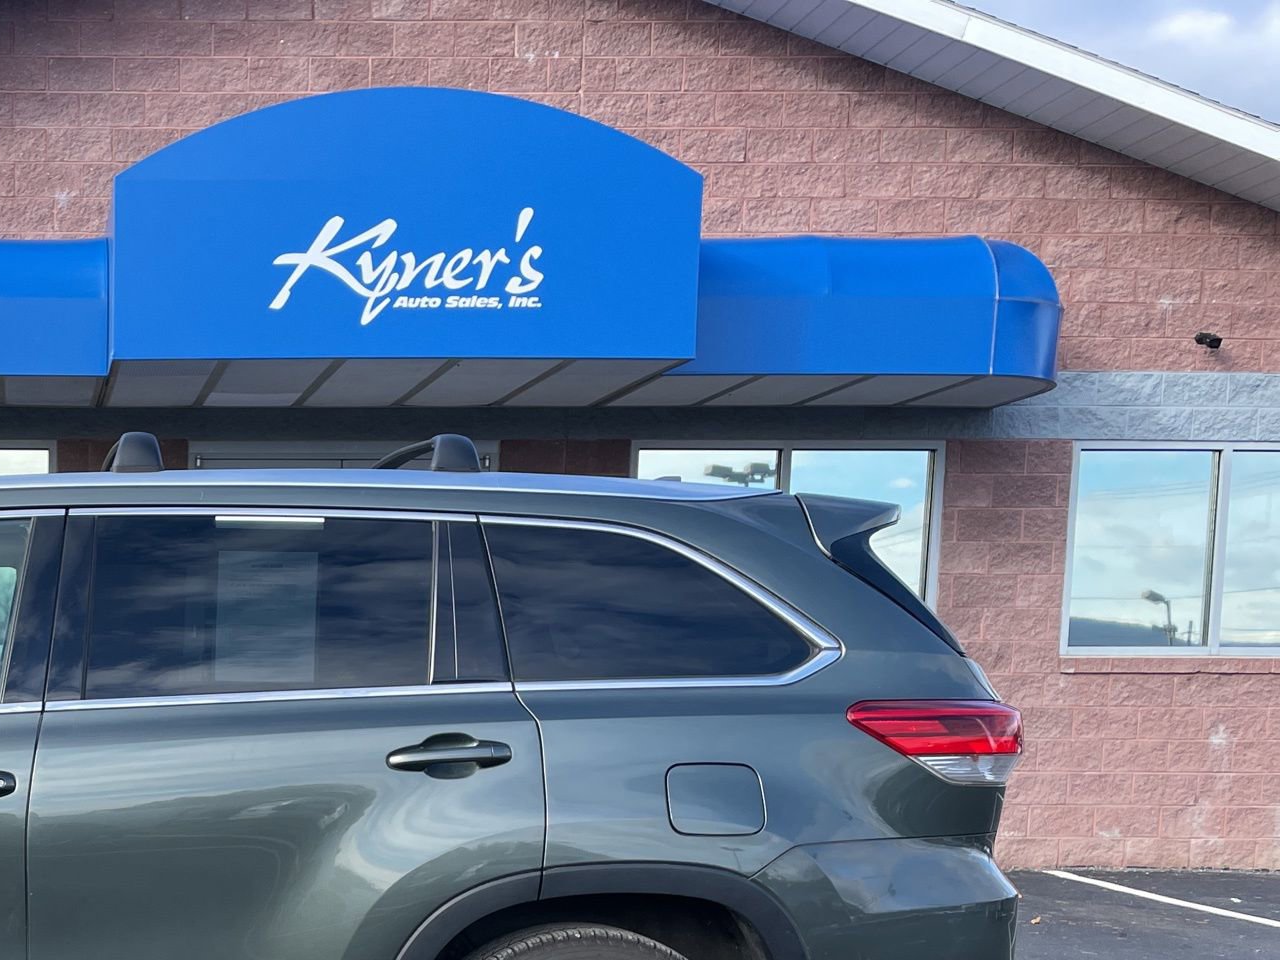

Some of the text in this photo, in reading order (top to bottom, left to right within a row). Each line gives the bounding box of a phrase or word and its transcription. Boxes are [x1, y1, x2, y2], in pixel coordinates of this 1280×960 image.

[269, 207, 544, 325] Kyner's
[393, 295, 542, 310] Auto Sales, Inc.
